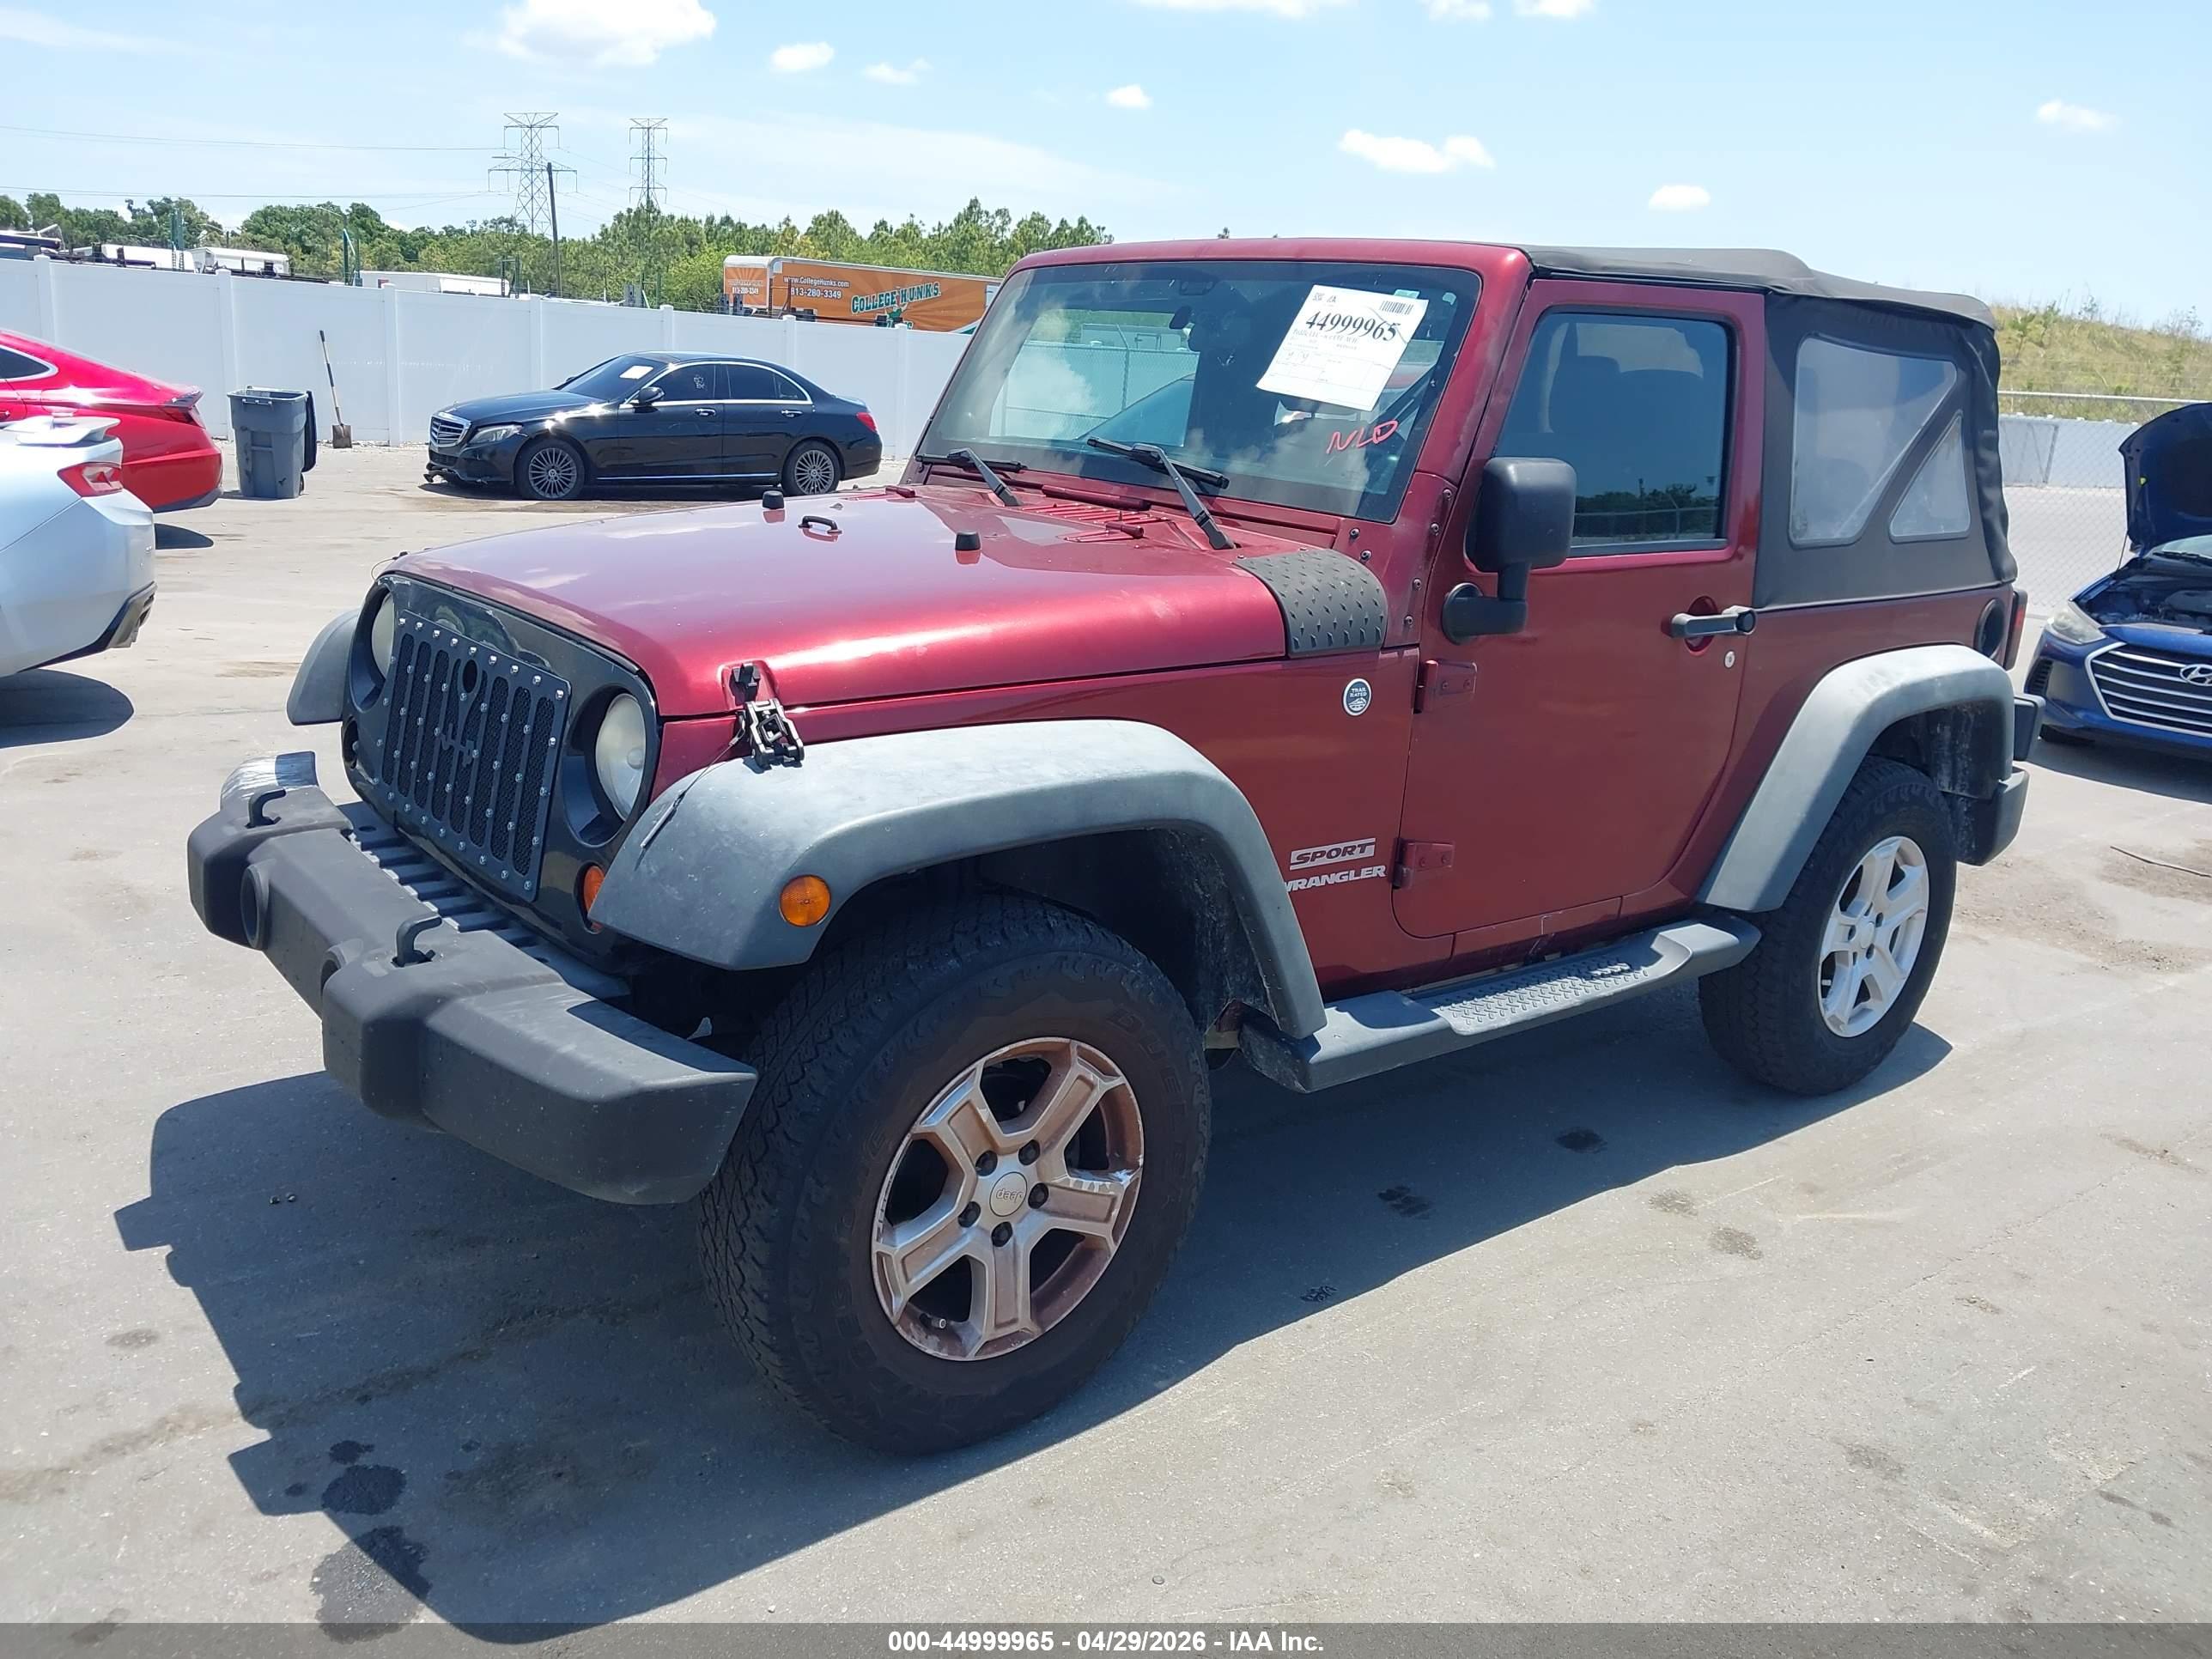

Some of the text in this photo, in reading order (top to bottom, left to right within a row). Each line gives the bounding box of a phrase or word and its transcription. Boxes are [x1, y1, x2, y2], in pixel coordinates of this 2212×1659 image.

[783, 276, 850, 288] www.CollegeHunks.com
[790, 287, 842, 300] 813-280-3349
[852, 291, 896, 313] COLLEGE
[1305, 311, 1401, 342] 44999965
[1293, 842, 1375, 865] SPORT
[996, 1188, 1024, 1203] Jeep
